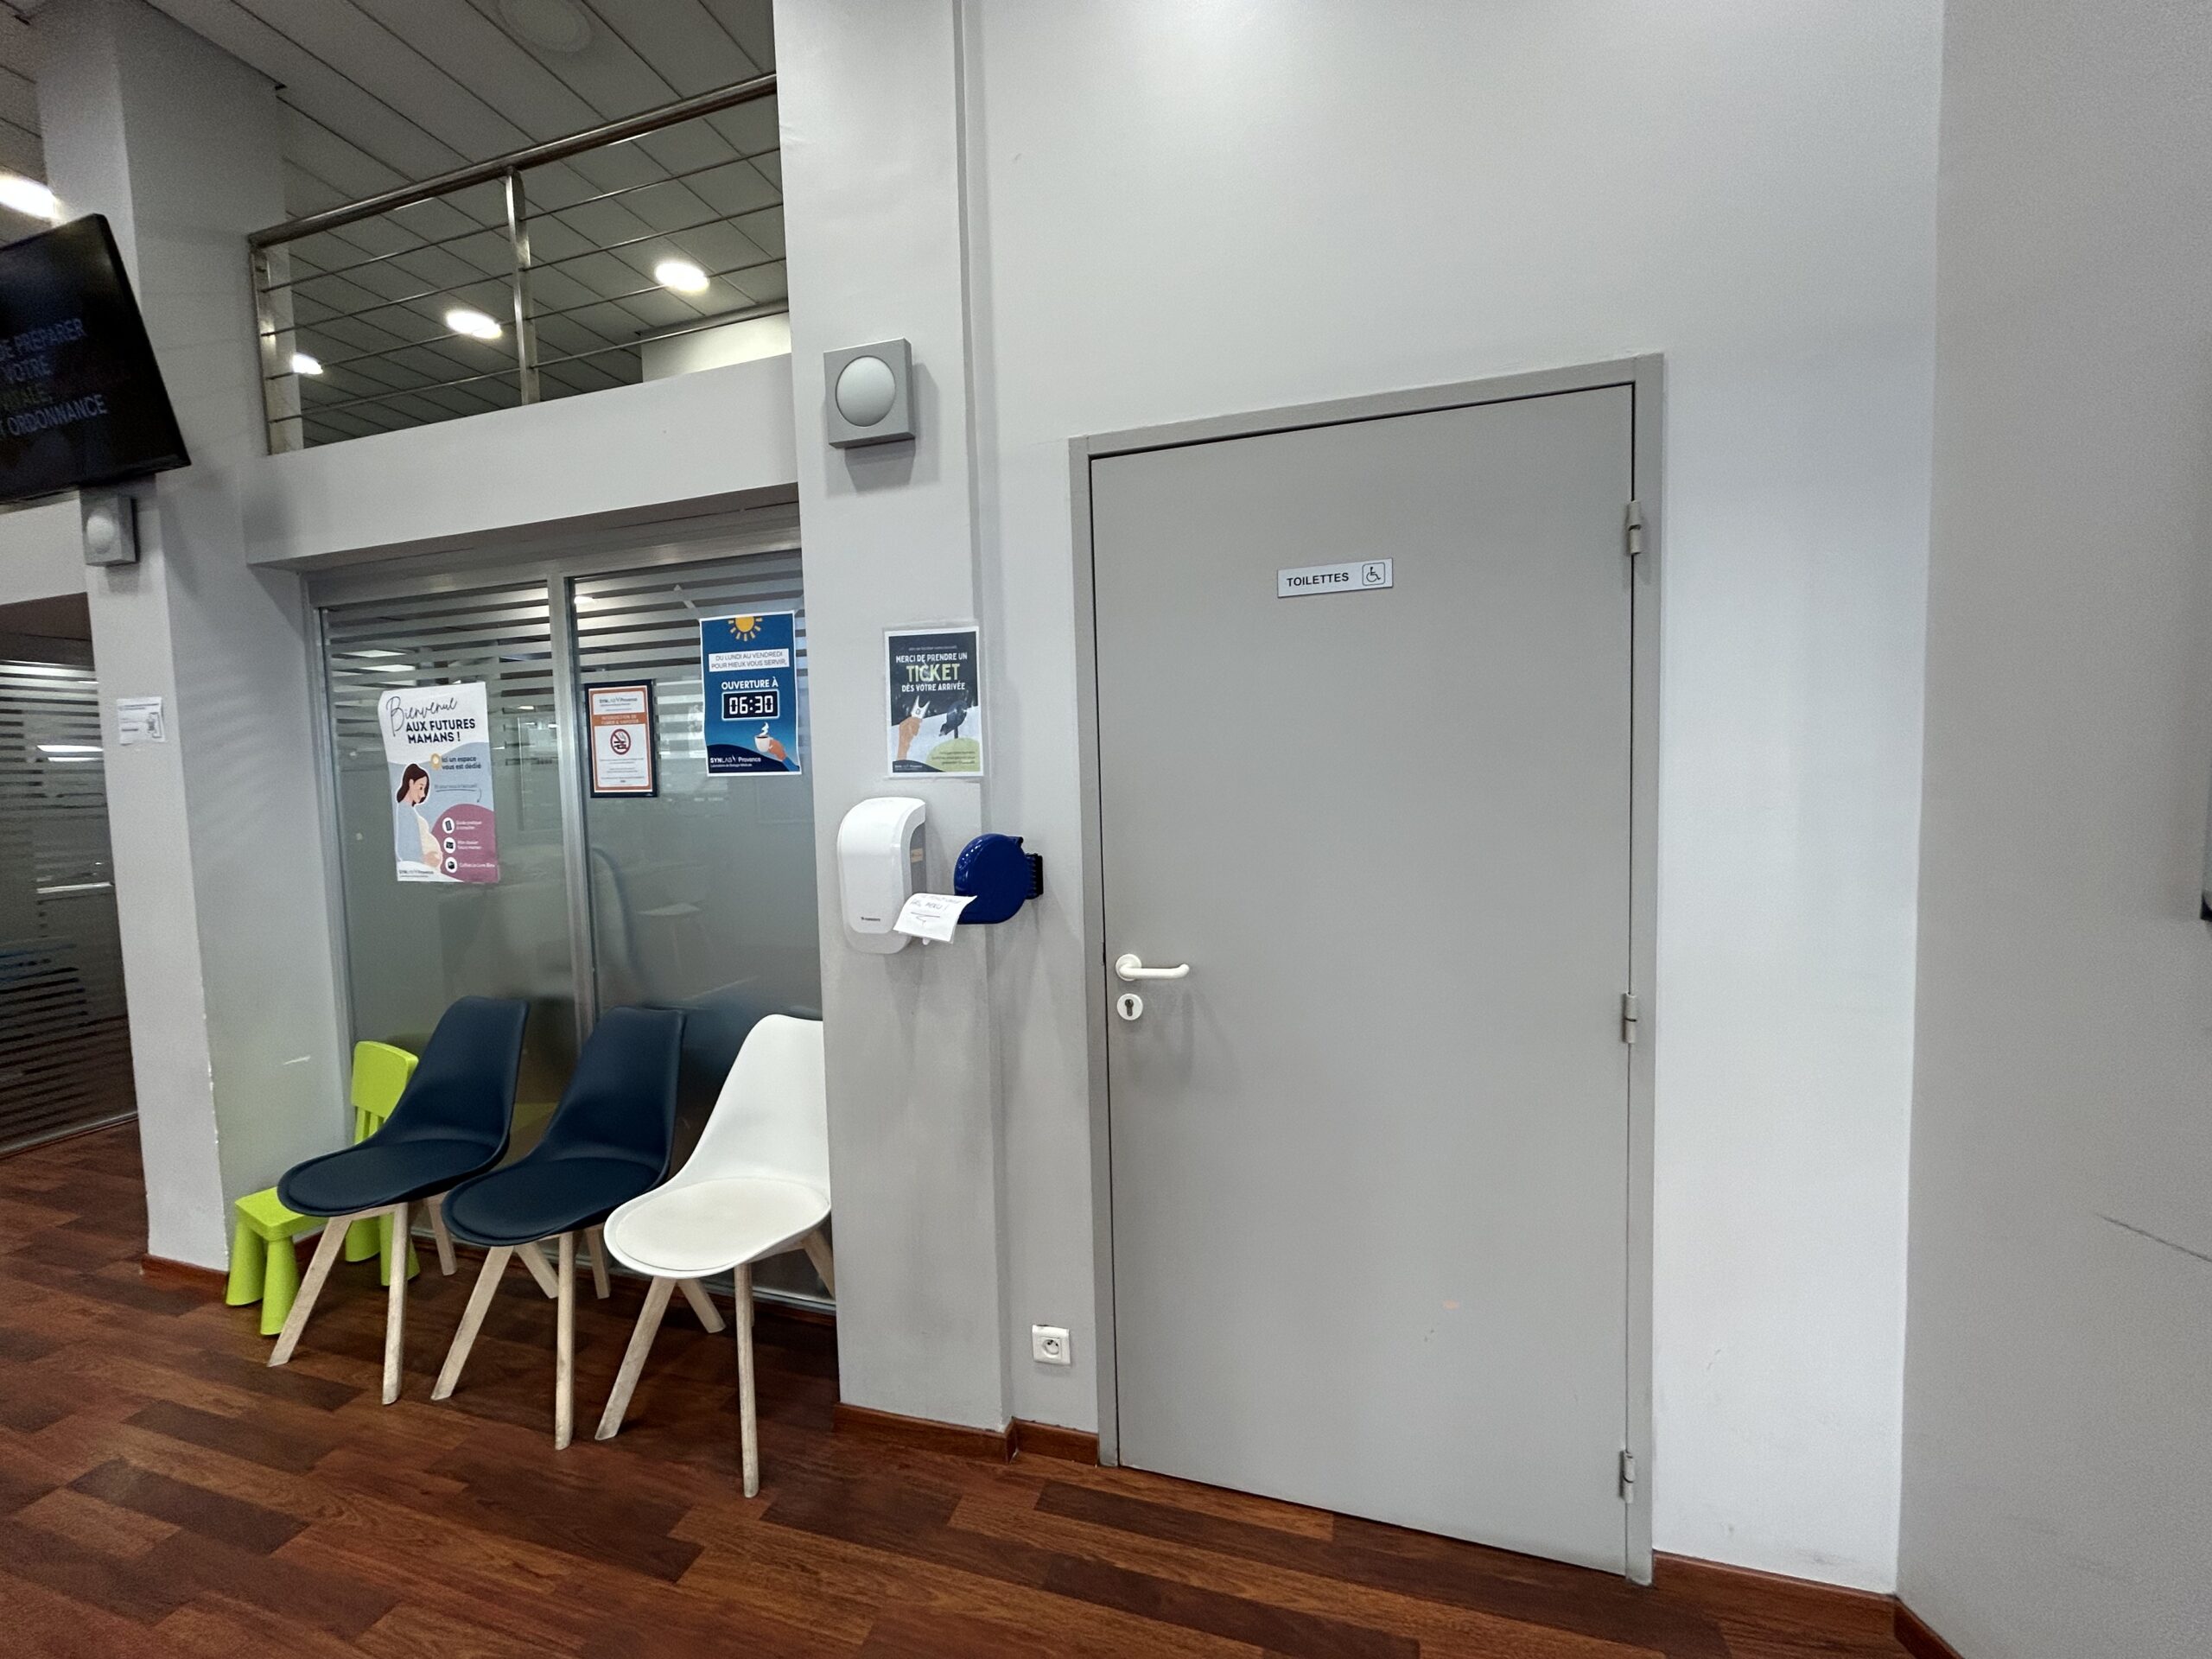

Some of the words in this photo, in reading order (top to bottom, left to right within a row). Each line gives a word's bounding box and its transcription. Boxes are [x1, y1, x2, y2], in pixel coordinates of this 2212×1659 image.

[7, 394, 108, 435] ORDONNANCE
[1287, 573, 1349, 587] TOILETTES
[926, 653, 957, 662] PRENDRE
[906, 664, 961, 683] TICKET
[721, 679, 770, 690] OUVERTURE
[772, 677, 779, 688] À
[902, 683, 915, 692] DÈS
[938, 682, 966, 690] ARRIVÉE
[729, 695, 774, 715] 06:30
[386, 696, 457, 737] Bienvenue
[406, 721, 427, 732] AUX
[429, 718, 475, 731] FUTURES
[408, 731, 454, 744] MAMANS
